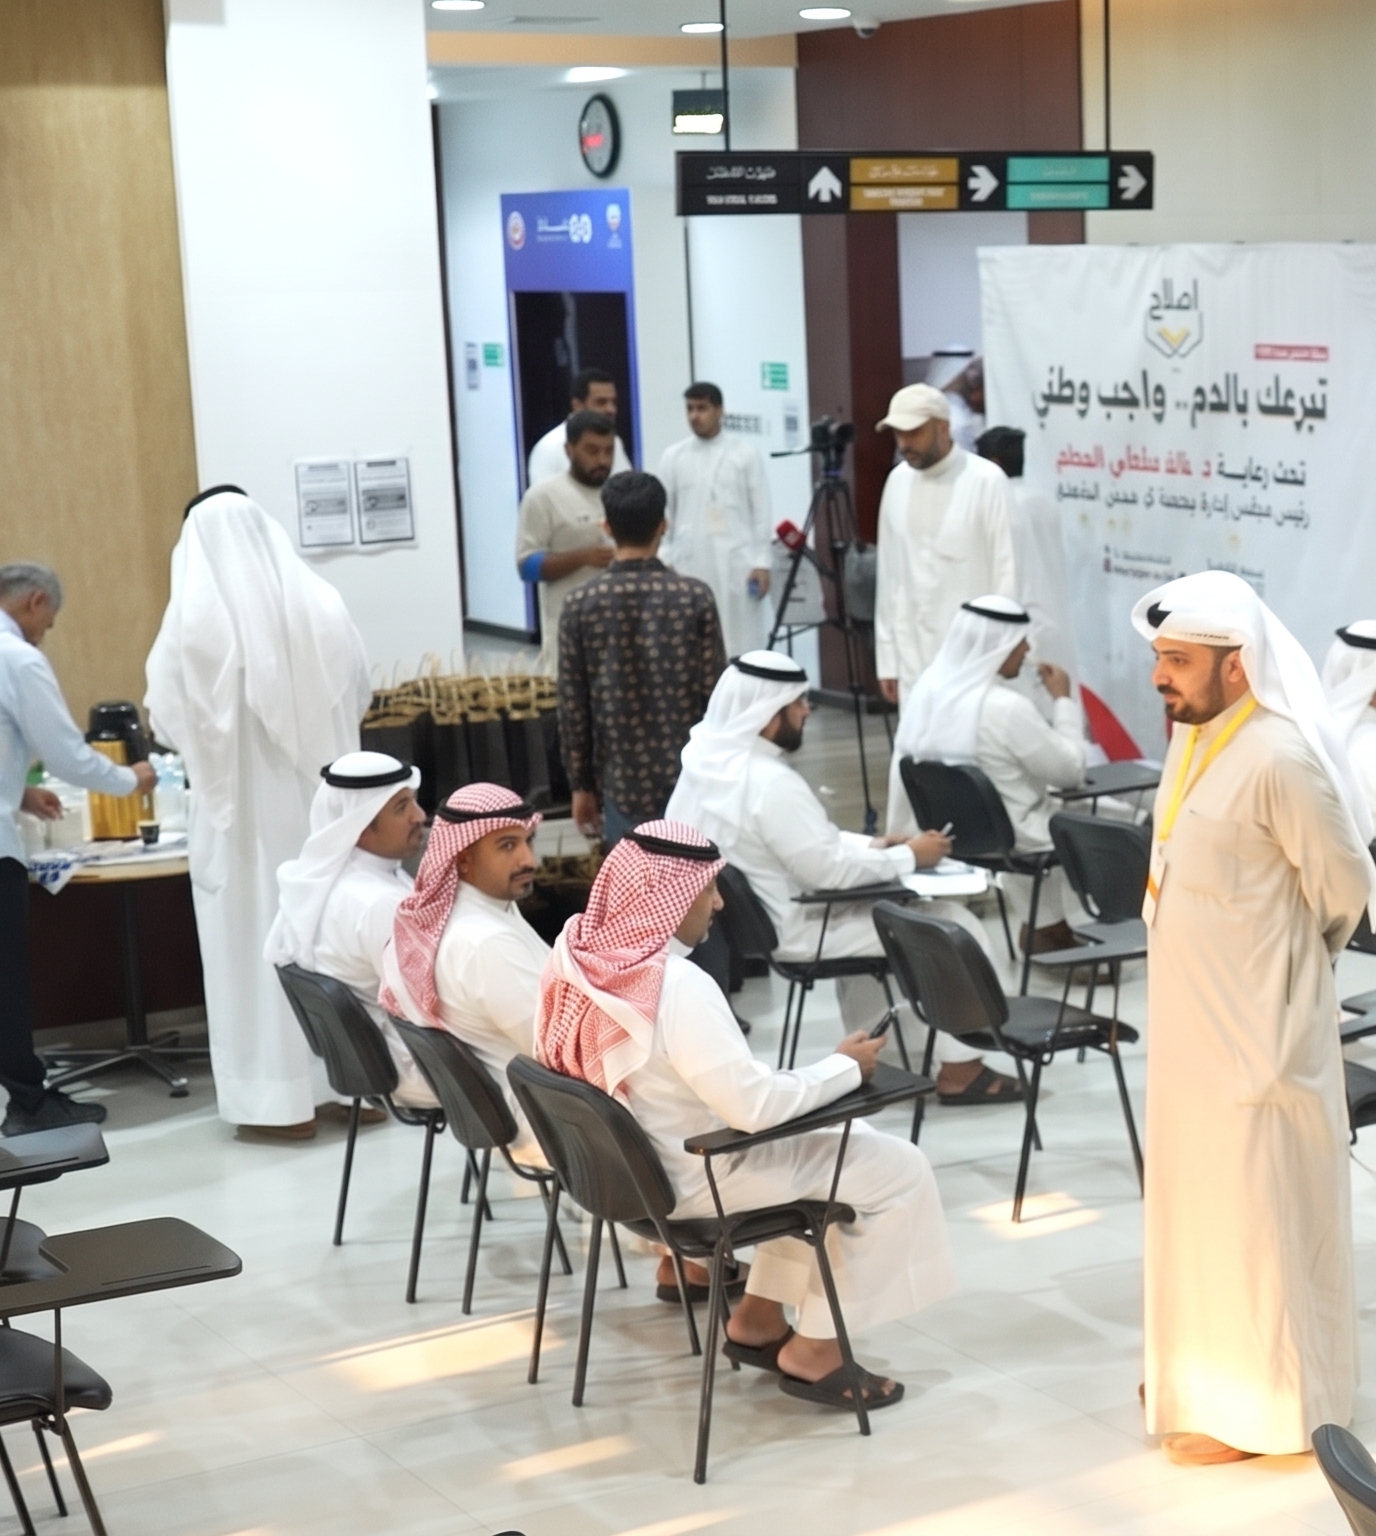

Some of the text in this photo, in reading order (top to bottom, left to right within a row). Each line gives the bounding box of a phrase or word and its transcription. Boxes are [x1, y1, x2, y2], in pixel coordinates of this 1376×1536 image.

[1033, 366, 1090, 429] وطني
[1097, 368, 1165, 425] واجب
[1256, 373, 1328, 432] تبرعك
[1273, 461, 1306, 488] تحت
